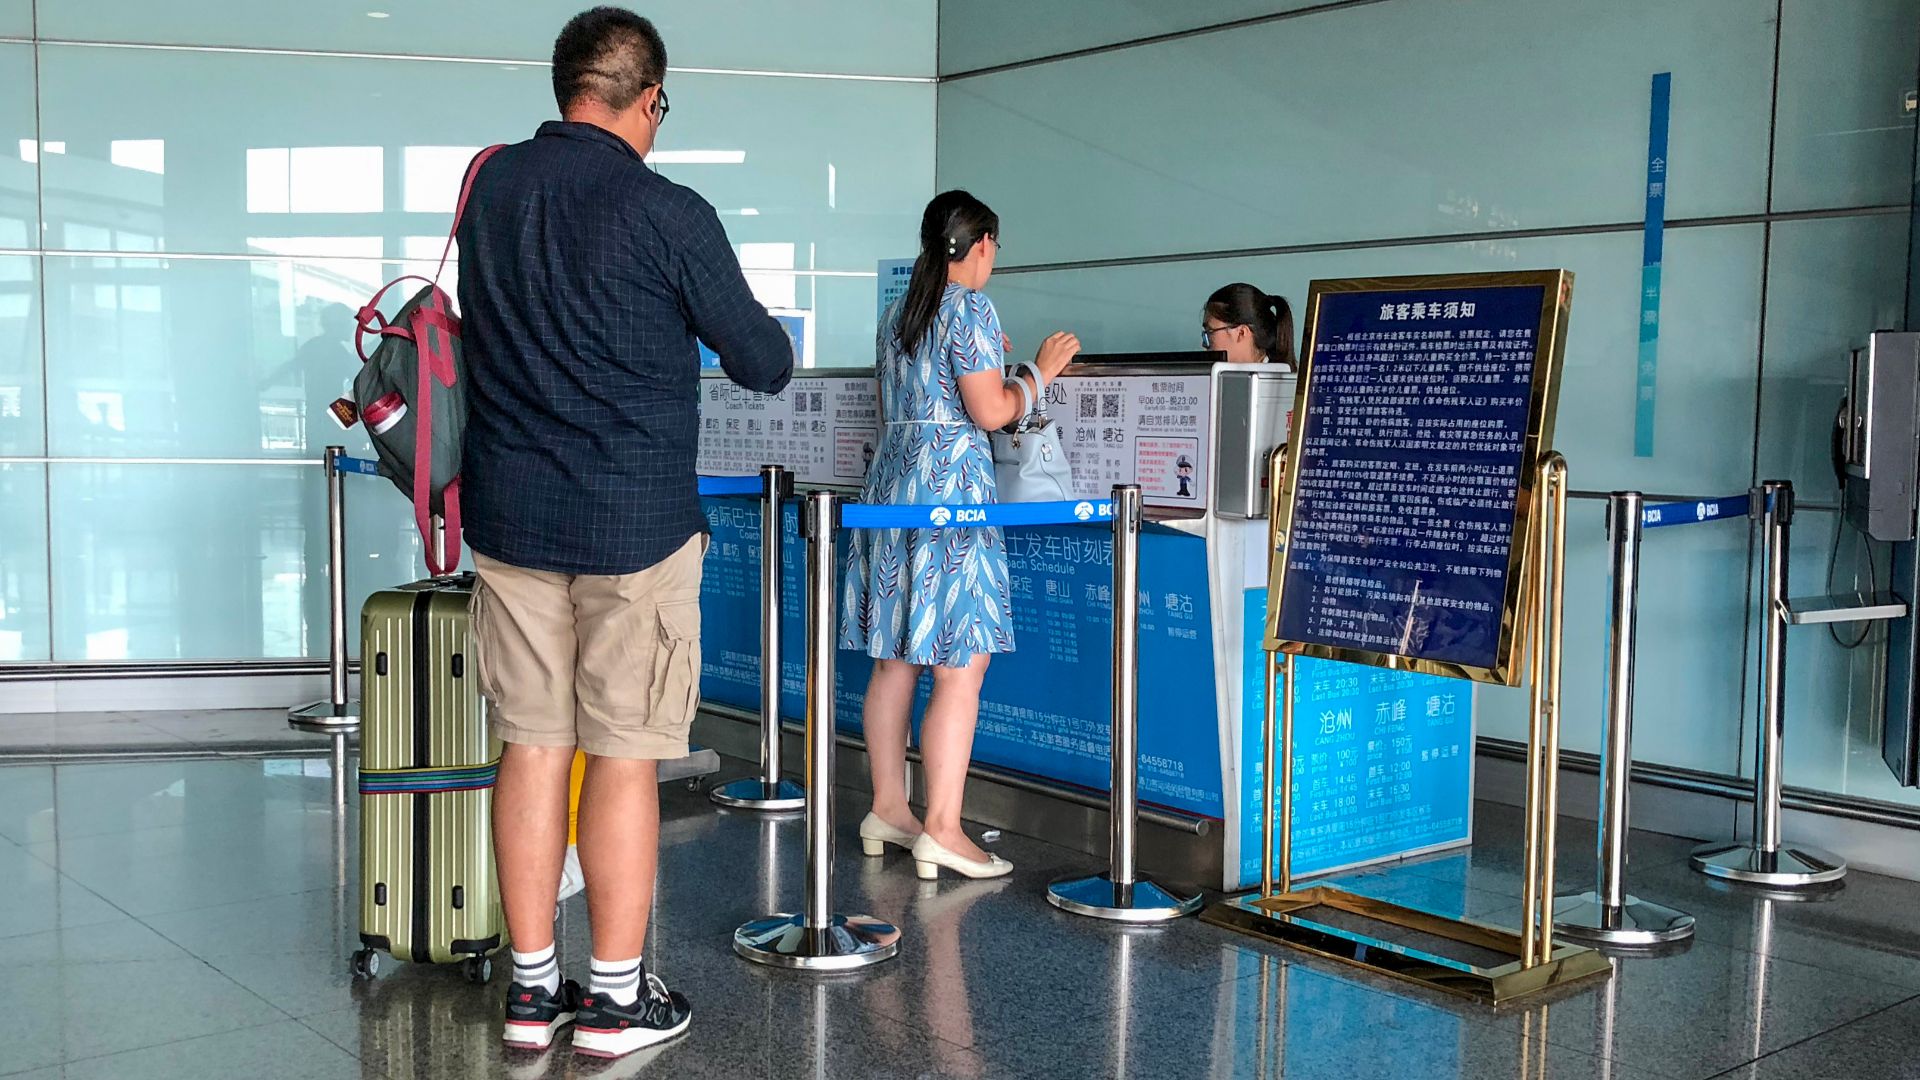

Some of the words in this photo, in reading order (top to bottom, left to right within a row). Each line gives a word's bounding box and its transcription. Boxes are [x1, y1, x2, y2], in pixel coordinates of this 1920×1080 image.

[1649, 157, 1665, 198] 全票
[1378, 301, 1476, 319] 旅客乘车须知
[1152, 382, 1184, 393] 售票时间
[725, 401, 743, 410] Coach
[744, 401, 765, 410] Tickets
[1138, 415, 1197, 426] 请自觉排队购票
[1075, 427, 1096, 442] 沧州
[707, 504, 761, 529] 省际巴士
[956, 509, 986, 522] BCIA
[1098, 503, 1112, 516] BC
[1647, 509, 1661, 523] BCIA
[1706, 503, 1718, 517] BCIA
[740, 529, 760, 541] Coach
[1007, 559, 1027, 569] oach
[1031, 559, 1075, 575] Schedule
[1046, 579, 1070, 598] 唐山
[1085, 584, 1110, 602] 赤峰
[1138, 590, 1150, 608] 州
[1165, 593, 1193, 612] 塘沽
[1336, 677, 1358, 689] 20:30
[1426, 692, 1455, 717] 塘沽
[1375, 699, 1406, 725] 赤峰
[1320, 707, 1352, 734] 沧州
[1375, 727, 1386, 735] CHI
[1388, 723, 1406, 733] FENG
[1315, 735, 1334, 745] CANG
[1336, 732, 1355, 742] ZHOU
[1392, 735, 1413, 747] 150元
[1336, 747, 1359, 760] 100元
[1391, 761, 1411, 772] 12:00
[1335, 773, 1356, 785] 14:45
[1368, 787, 1384, 799] 末车
[1390, 783, 1410, 795] 15:30
[1312, 799, 1328, 812] 末车
[1335, 795, 1356, 808] 18:00
